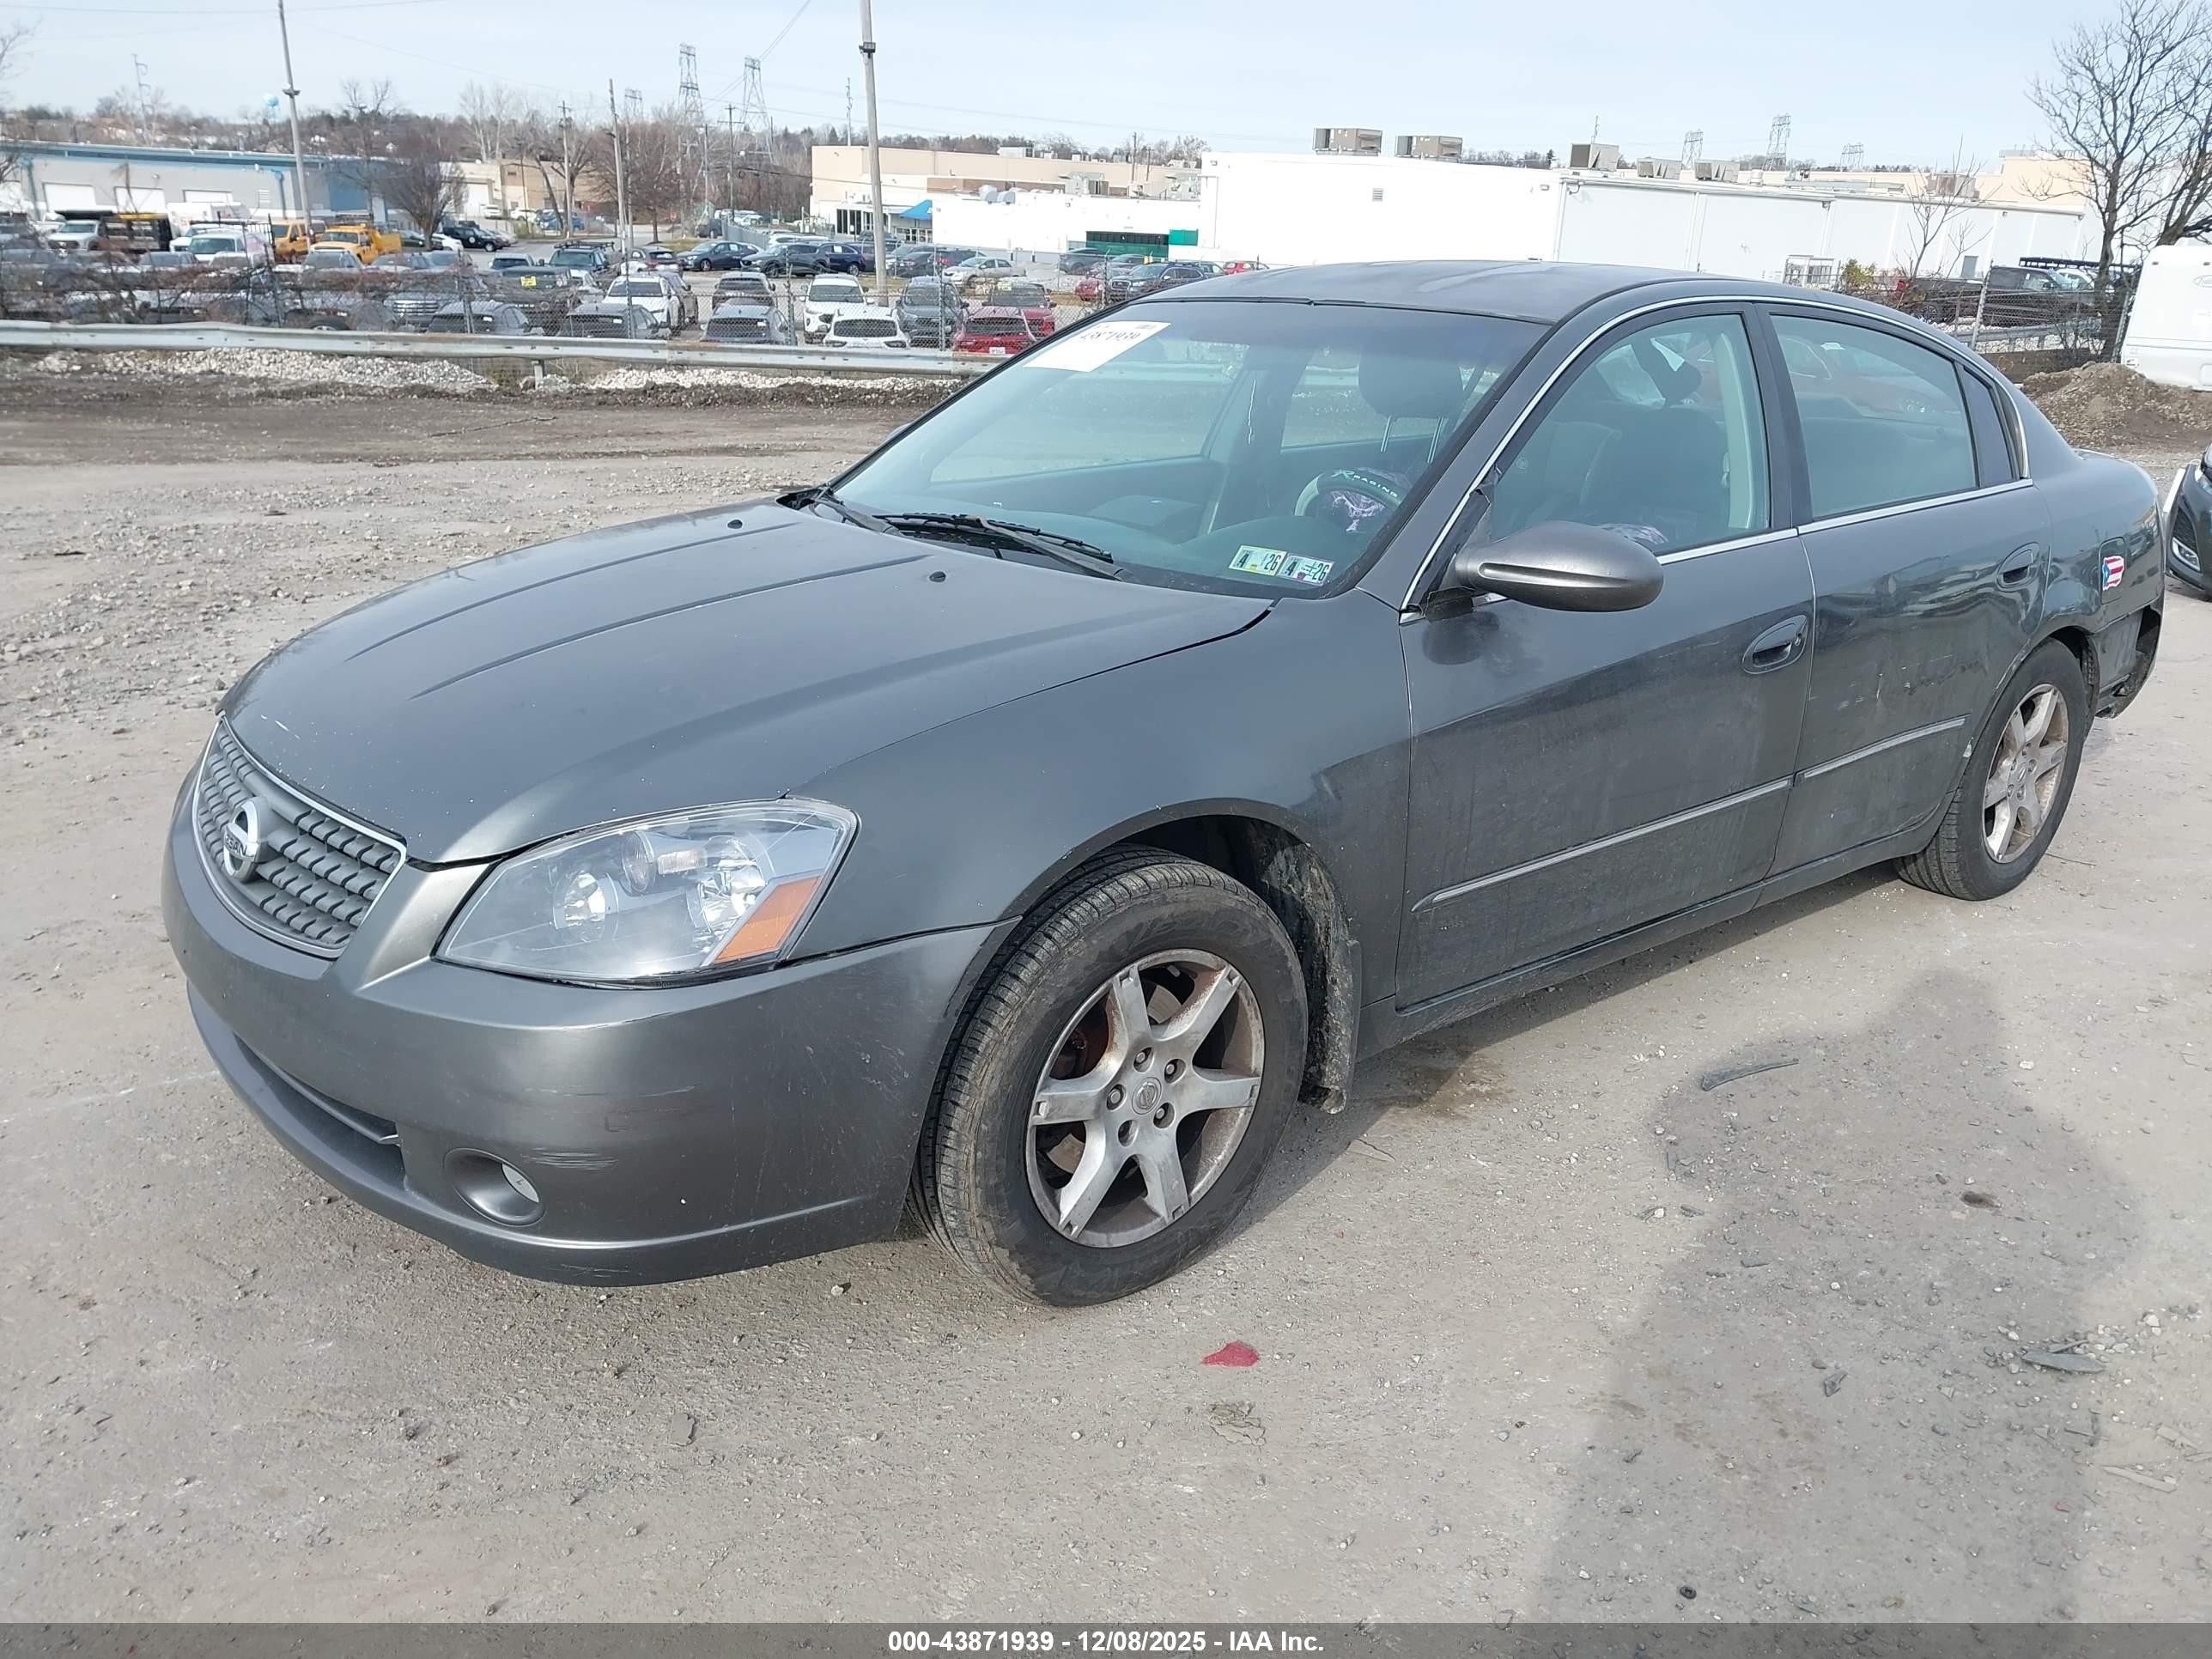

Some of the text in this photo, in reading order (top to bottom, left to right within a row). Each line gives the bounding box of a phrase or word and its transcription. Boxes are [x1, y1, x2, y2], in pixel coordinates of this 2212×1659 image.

[1237, 553, 1282, 571] 4 26
[1285, 561, 1330, 581] 4 26
